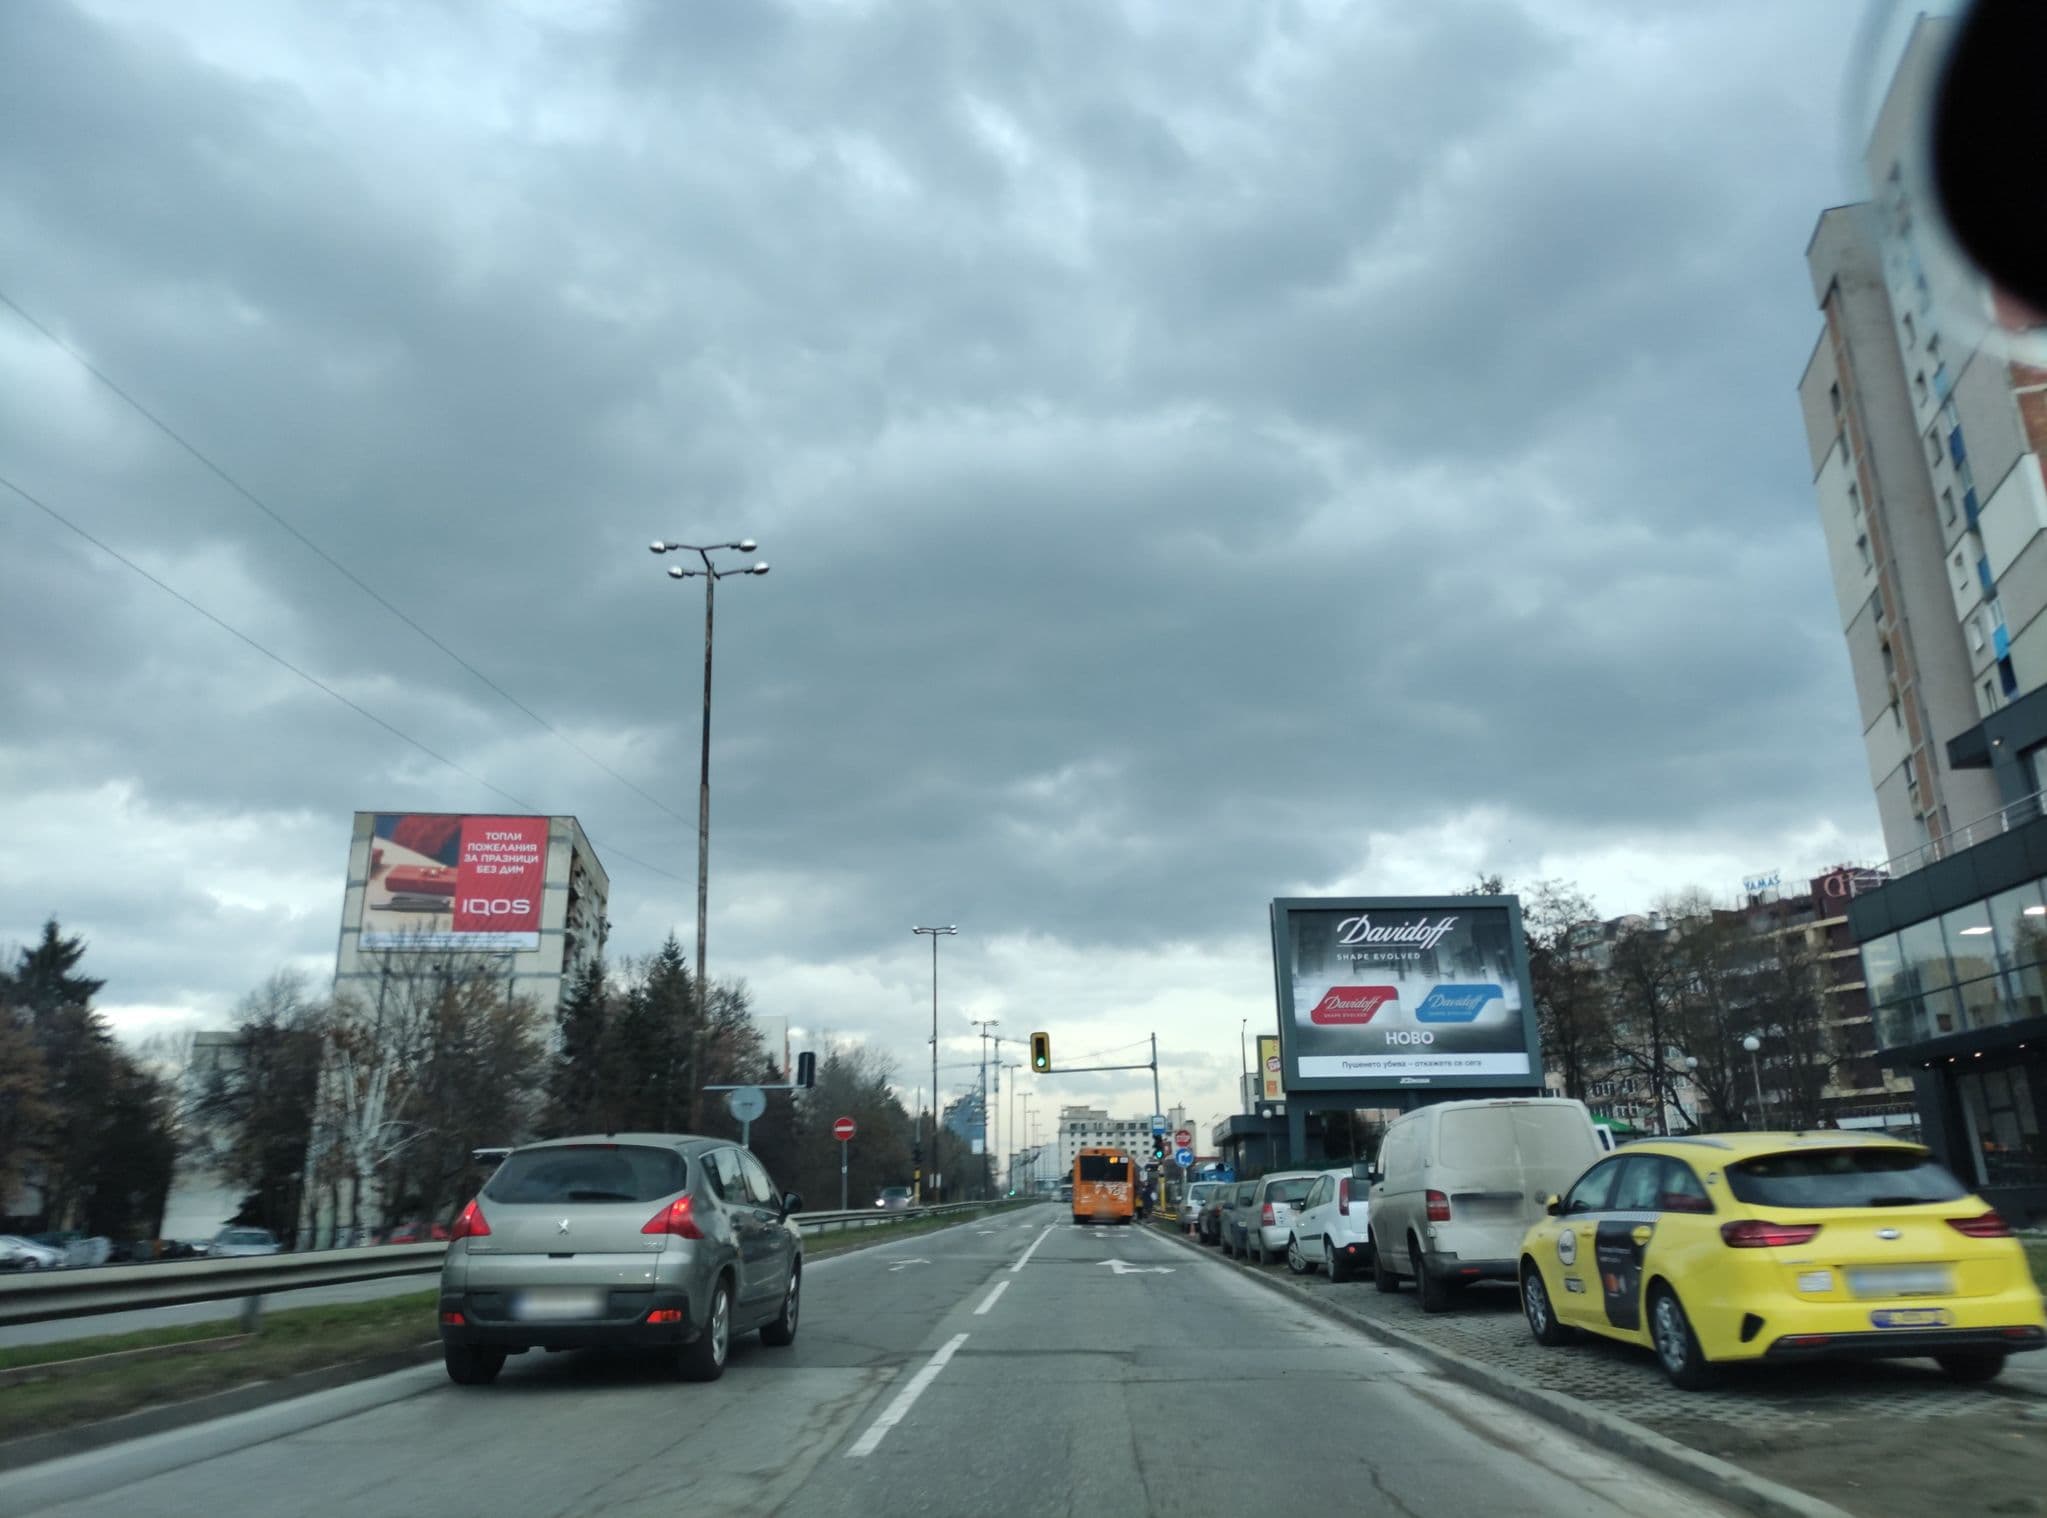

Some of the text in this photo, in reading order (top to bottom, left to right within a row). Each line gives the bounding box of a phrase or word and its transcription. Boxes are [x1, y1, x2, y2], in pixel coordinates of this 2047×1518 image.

[485, 832, 522, 841] ТОПЛИ
[467, 843, 537, 852] ПОЖЕЛАНИЯ
[464, 854, 538, 864] ЗА ПРАЗНИЦИ
[476, 865, 524, 875] БЕЗ ДИМ
[461, 898, 531, 916] IQOS
[1336, 913, 1460, 950] Davidoff
[1336, 952, 1421, 961] SHAPE EVOLVED
[1324, 995, 1382, 1012] Davidoff
[1428, 993, 1485, 1010] Davidoff
[1385, 1031, 1435, 1045] НОВО
[1342, 1061, 1381, 1070] Пушенето
[1383, 1061, 1406, 1069] убива
